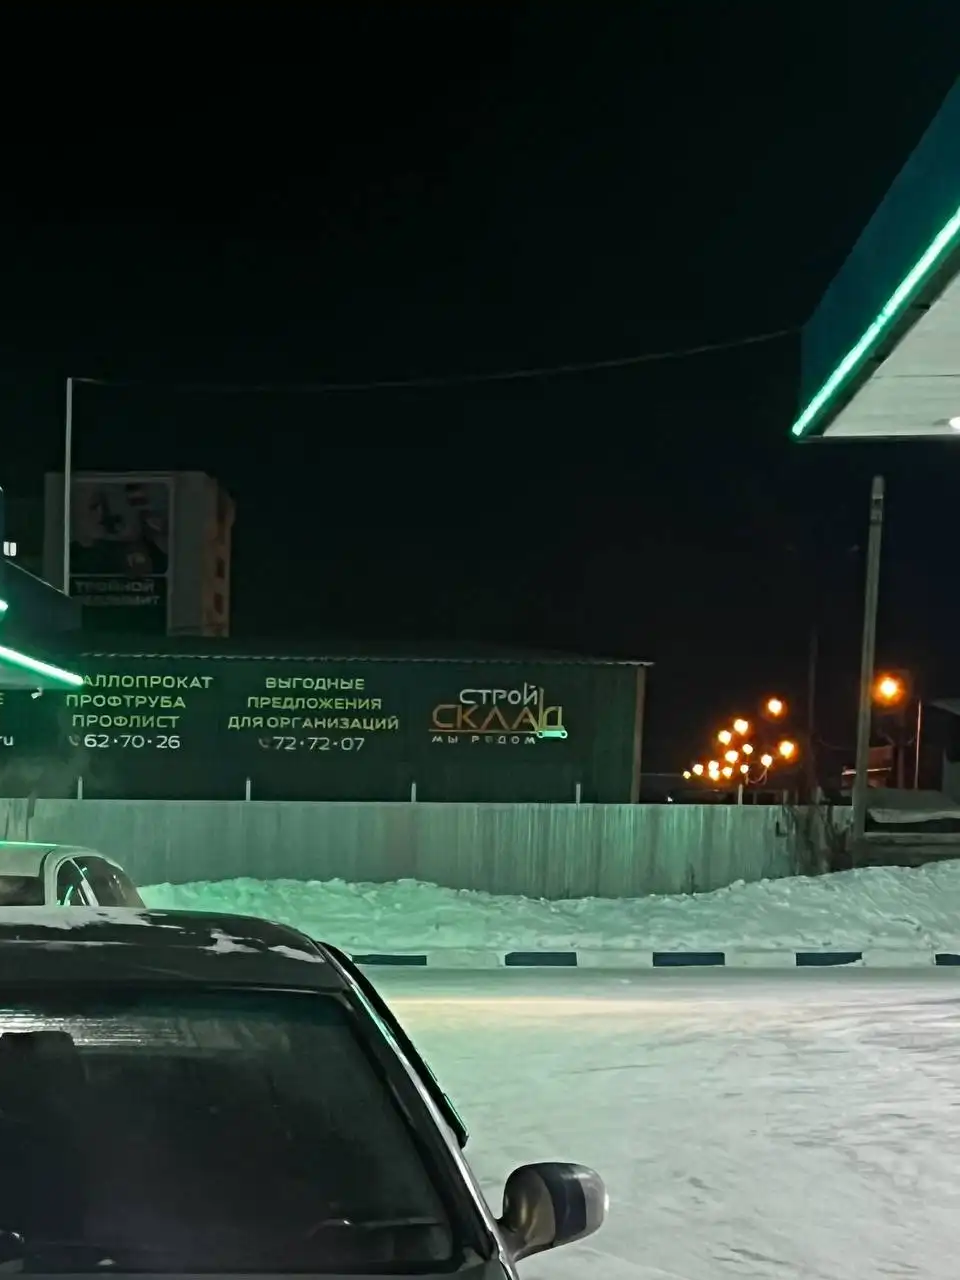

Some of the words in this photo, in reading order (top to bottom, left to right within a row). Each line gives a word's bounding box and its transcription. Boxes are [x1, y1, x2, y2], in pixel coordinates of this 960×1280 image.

[265, 677, 365, 691] ВЫГОДНЫЕ
[66, 694, 186, 708] ПРОФТРУБА
[459, 682, 538, 705] СТРОЙ
[247, 696, 382, 711] ПРЕДЛОЖЕНИЯ
[72, 713, 180, 728] ПРОФЛИСТ
[227, 716, 264, 730] ДЛЯ
[266, 715, 399, 731] ОРГАНИЗАЦИЙ
